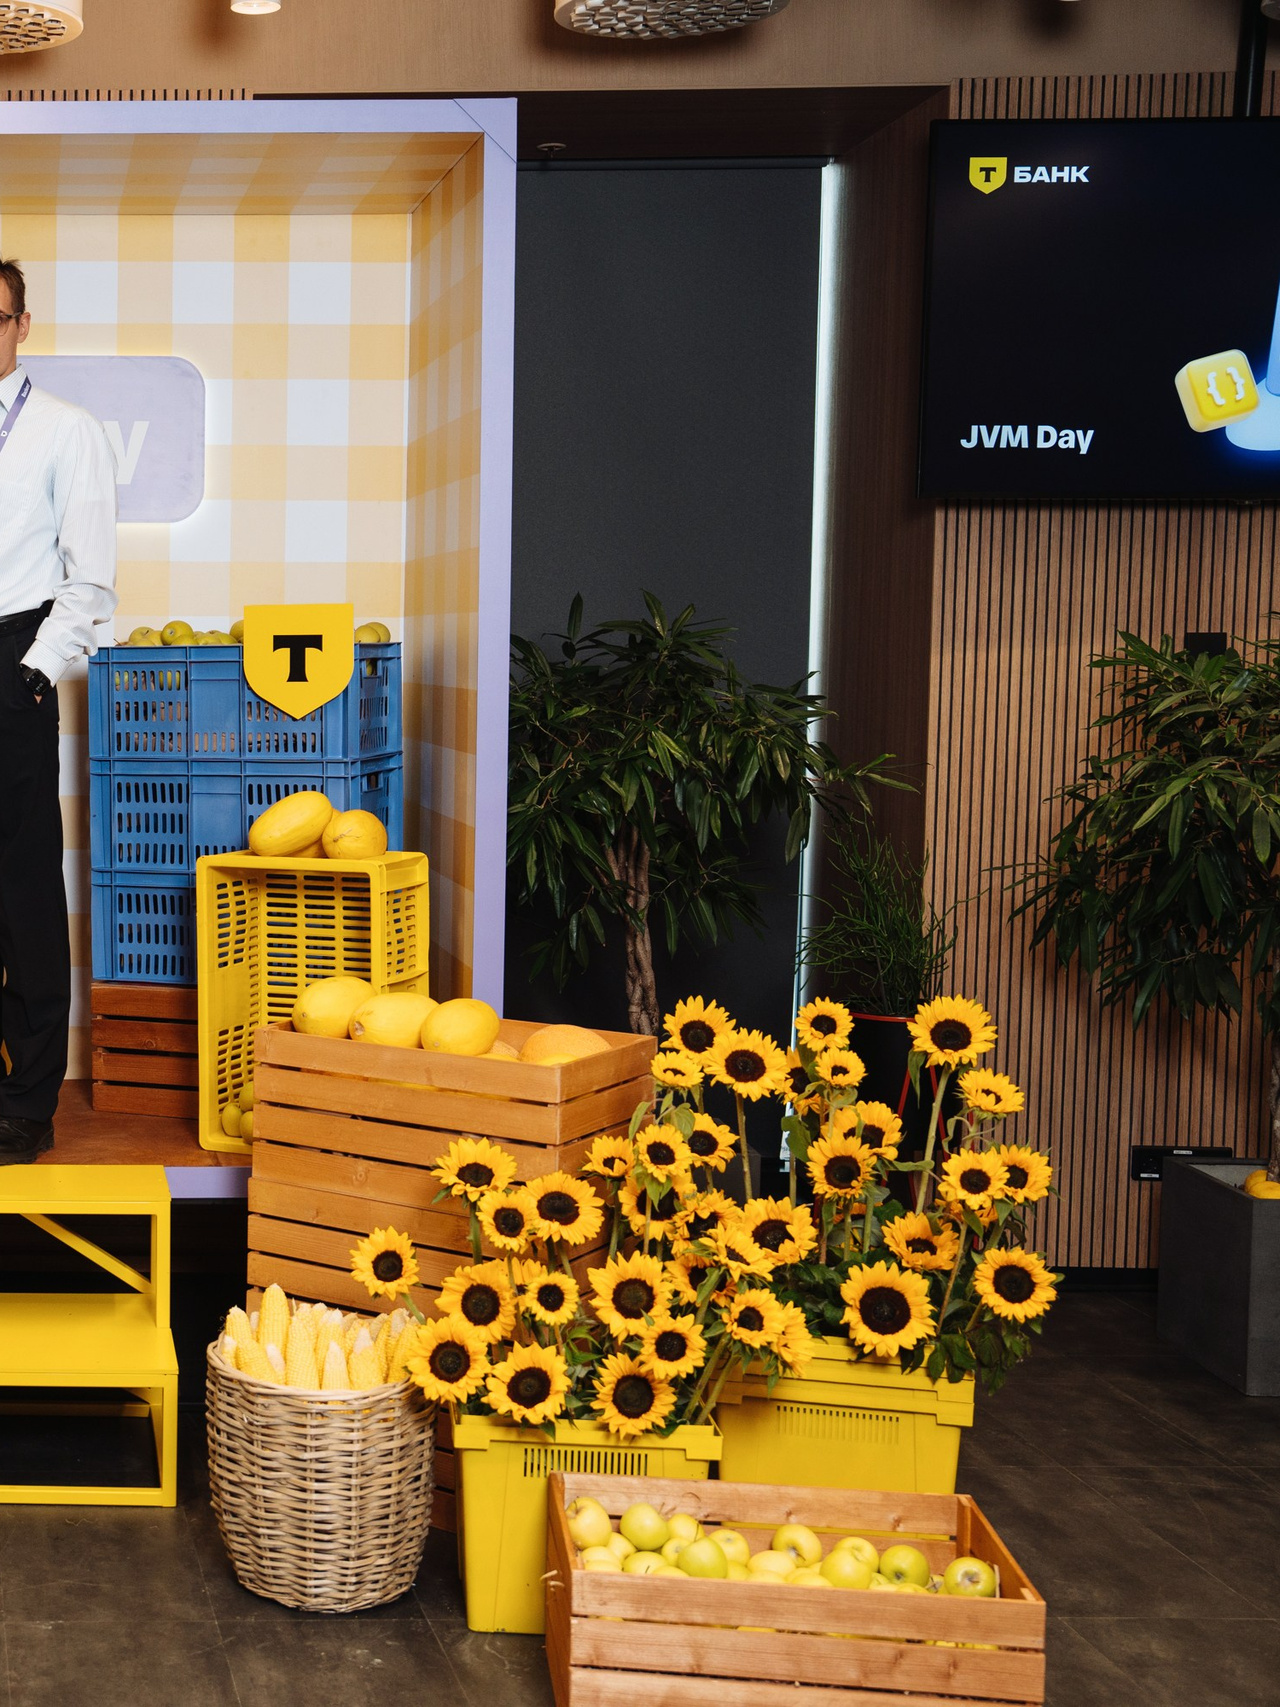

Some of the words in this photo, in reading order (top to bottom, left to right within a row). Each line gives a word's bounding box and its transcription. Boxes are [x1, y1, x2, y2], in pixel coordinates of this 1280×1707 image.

[1013, 165, 1090, 183] БАНК
[960, 424, 1029, 449] JVM
[1036, 424, 1095, 455] Day
